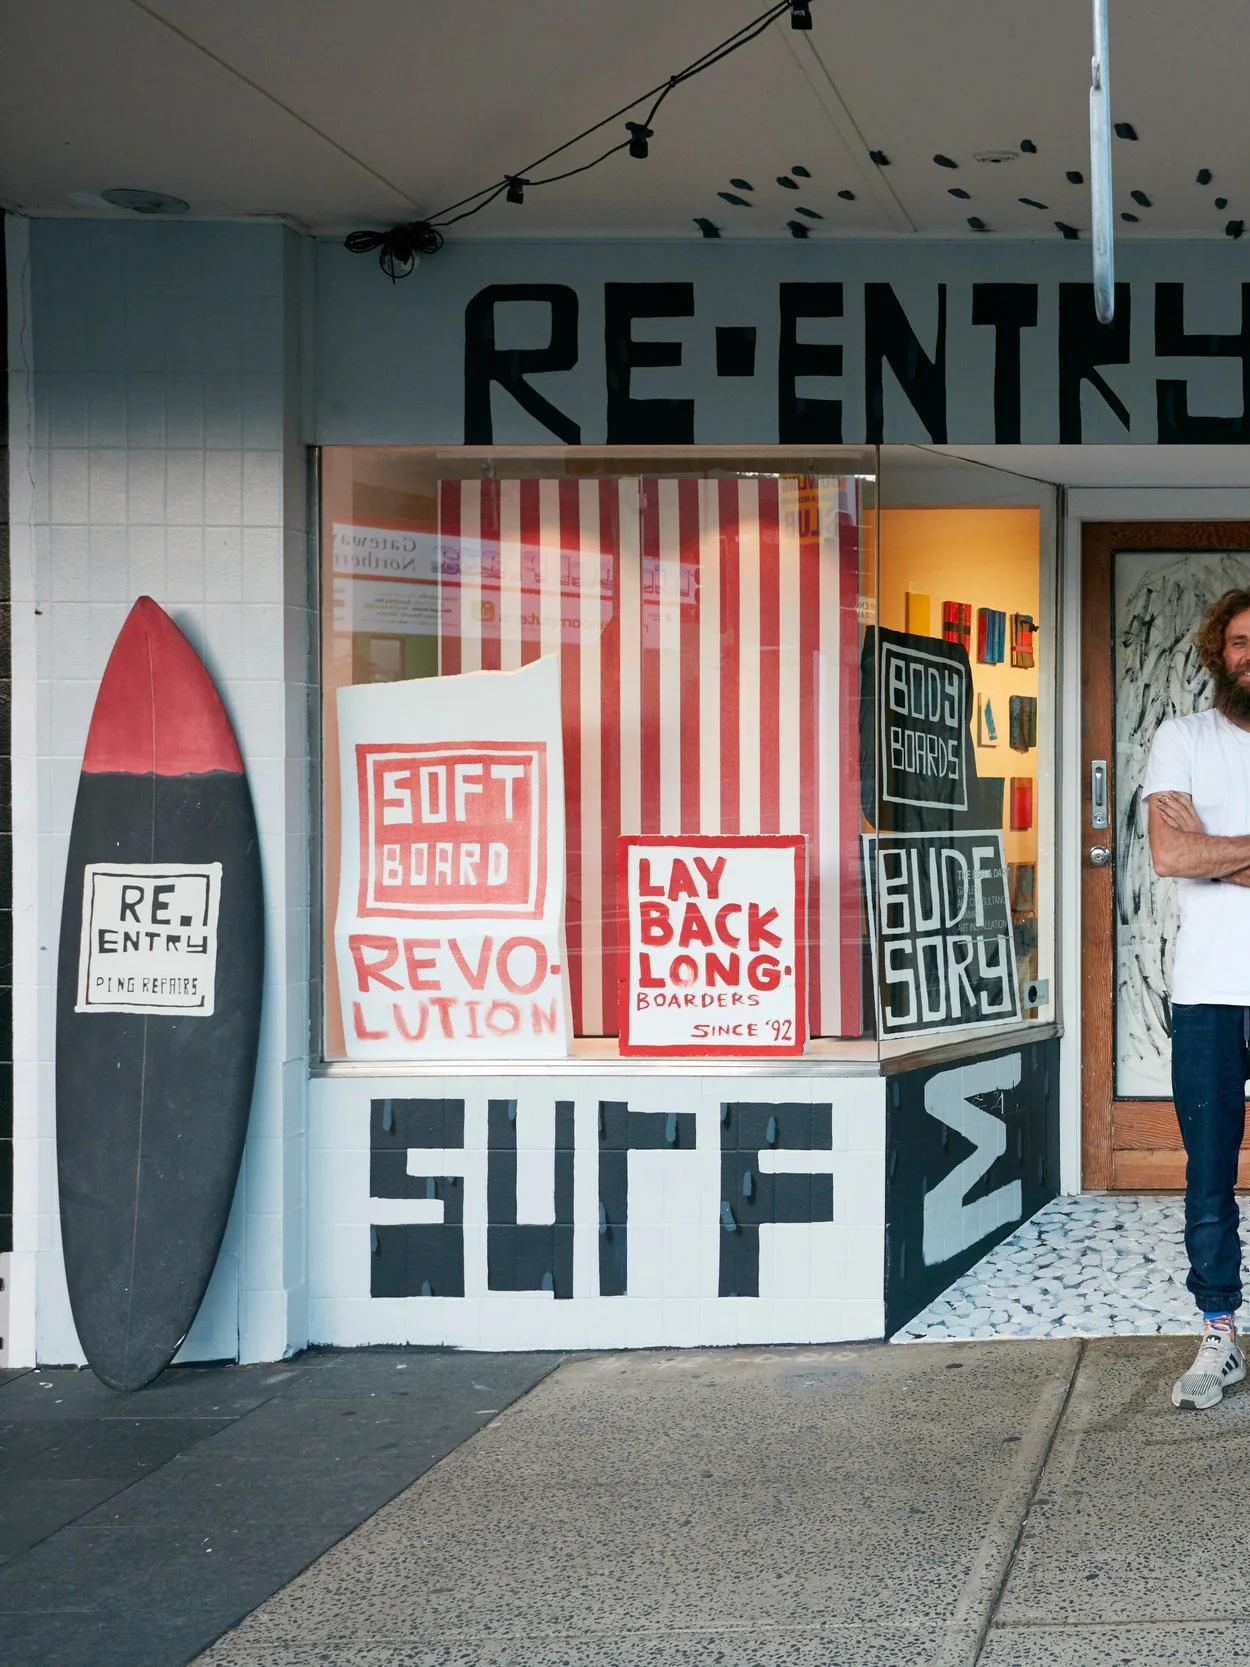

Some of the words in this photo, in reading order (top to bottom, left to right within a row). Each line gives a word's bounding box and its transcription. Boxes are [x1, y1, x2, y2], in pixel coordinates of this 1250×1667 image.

[889, 657, 959, 728] BODY
[890, 726, 959, 780] BOARDS
[383, 764, 529, 825] SOFT
[382, 842, 509, 887] BOARD
[638, 855, 728, 902] LAY
[98, 928, 208, 954] ENTRY
[638, 902, 783, 952] BACK
[142, 977, 199, 996] REPAIRS
[636, 991, 760, 1012] BOARDERS
[352, 996, 559, 1041] LUTION
[690, 1022, 759, 1039] SINCE
